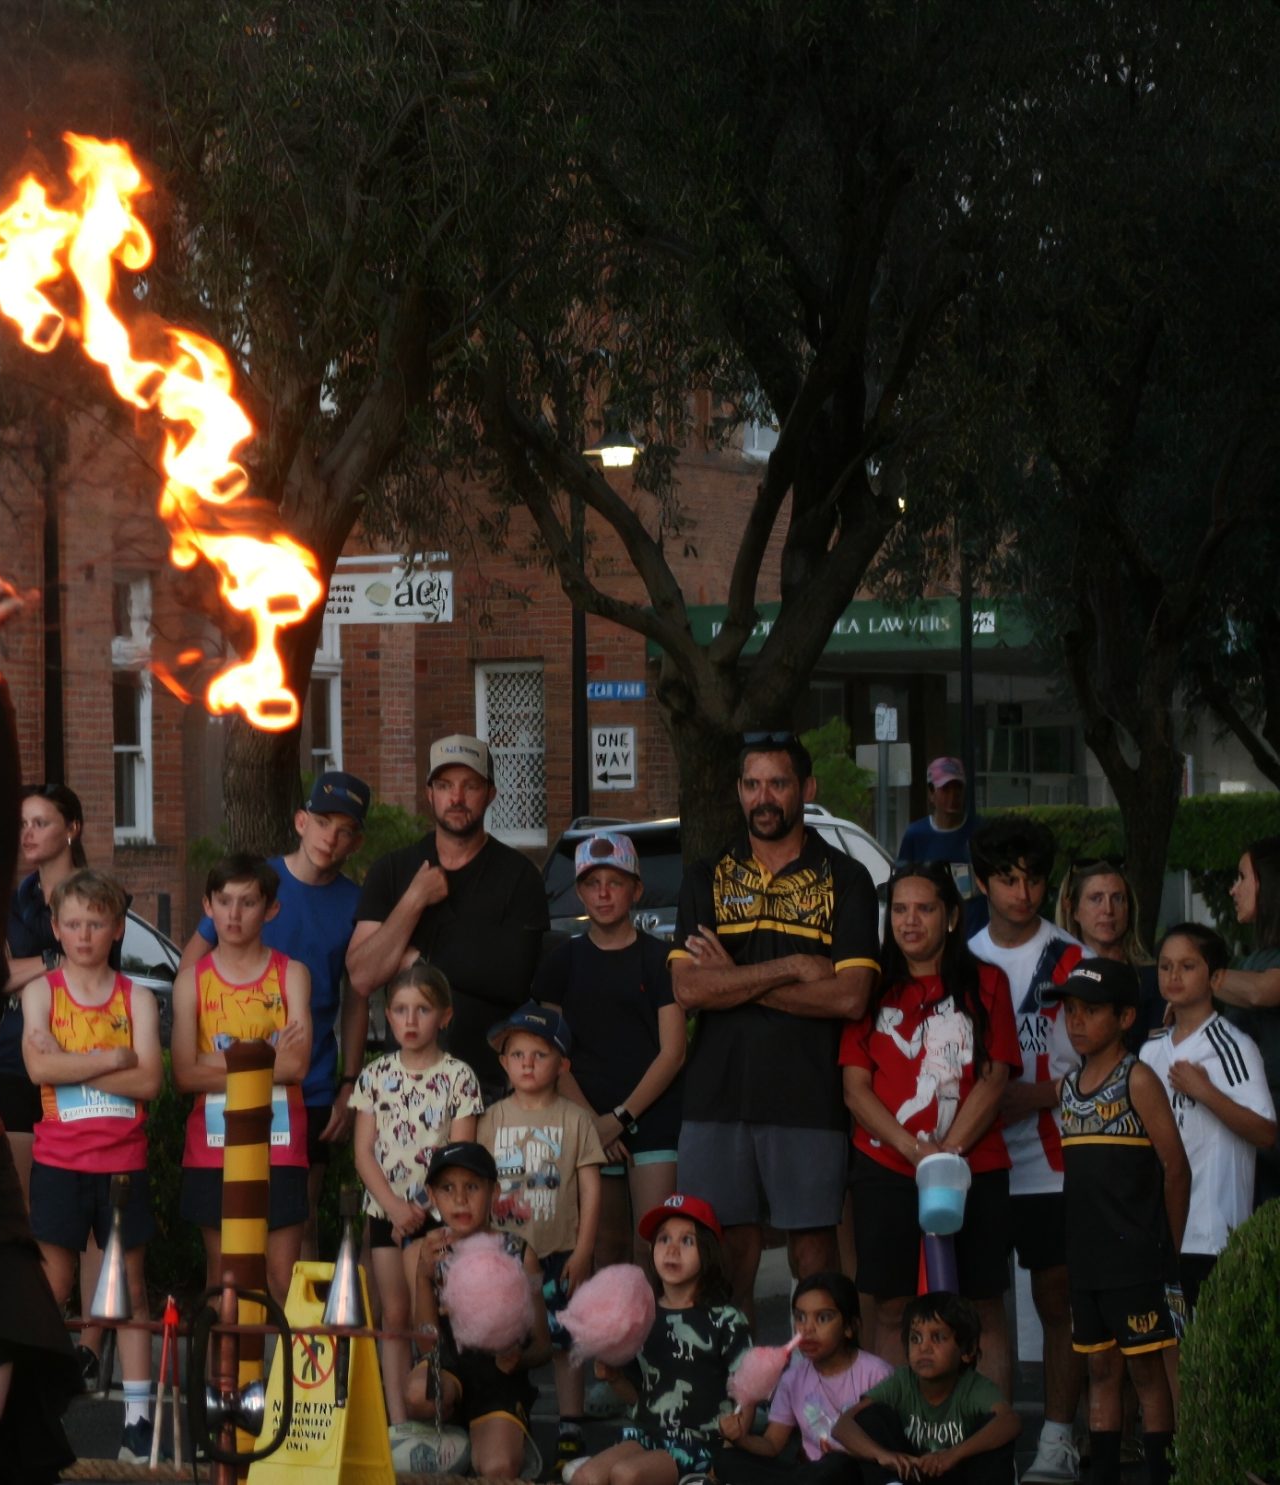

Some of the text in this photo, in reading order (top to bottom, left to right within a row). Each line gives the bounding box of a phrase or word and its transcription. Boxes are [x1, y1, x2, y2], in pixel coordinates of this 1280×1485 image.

[869, 615, 951, 633] LAWYERS
[597, 732, 629, 748] ONE
[596, 751, 630, 767] WAY
[295, 1402, 336, 1415] ENTRY
